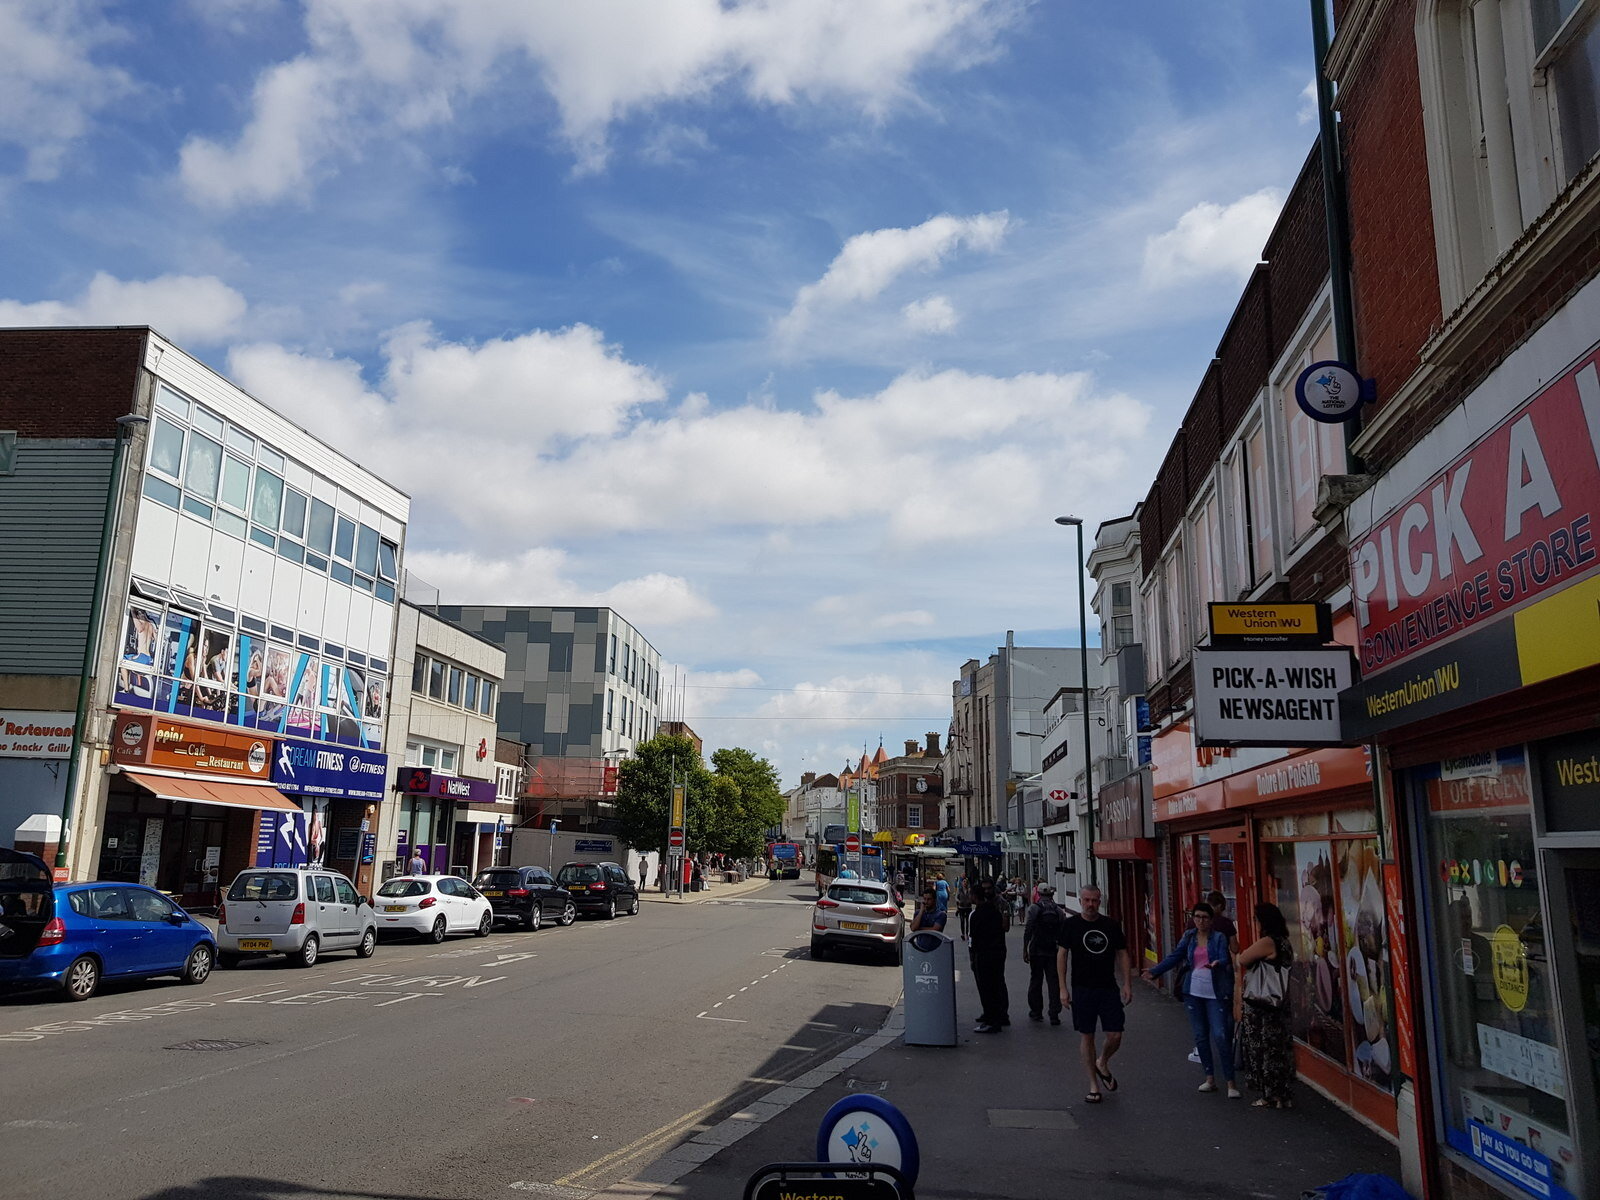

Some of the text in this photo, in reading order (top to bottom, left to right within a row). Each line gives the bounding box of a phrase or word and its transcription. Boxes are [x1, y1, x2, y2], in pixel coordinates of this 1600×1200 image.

[1353, 459, 1483, 628] PICK
[1504, 412, 1562, 542] A
[1363, 512, 1597, 668] CONVENIENCE STORE
[1227, 609, 1277, 618] Western
[1244, 618, 1301, 628] Union WU
[1243, 636, 1264, 644] Money
[1212, 667, 1337, 689] PICK-A-WISH
[1437, 661, 1460, 694] WU
[1219, 697, 1336, 721] NEWSAGENT
[155, 726, 184, 744] ppins
[12, 741, 43, 753] Snacks
[47, 742, 71, 753] Grills
[188, 743, 206, 757] Café
[209, 756, 244, 771] Restaurant
[289, 746, 345, 772] DREAM FITNESS
[1444, 751, 1492, 774] Lycamobile
[360, 763, 386, 775] FITNESS
[1288, 759, 1321, 789] Polskie
[1556, 755, 1600, 787] West
[447, 780, 471, 797] NatWest
[962, 845, 989, 854] Reynolds
[329, 973, 509, 989] TURN
[1499, 980, 1525, 994] DISTANCE
[223, 988, 446, 1007] LEFT
[1480, 1131, 1493, 1149] PAY
[1494, 1139, 1505, 1154] AS
[1503, 1143, 1521, 1163] YOU
[1520, 1152, 1538, 1170] GO
